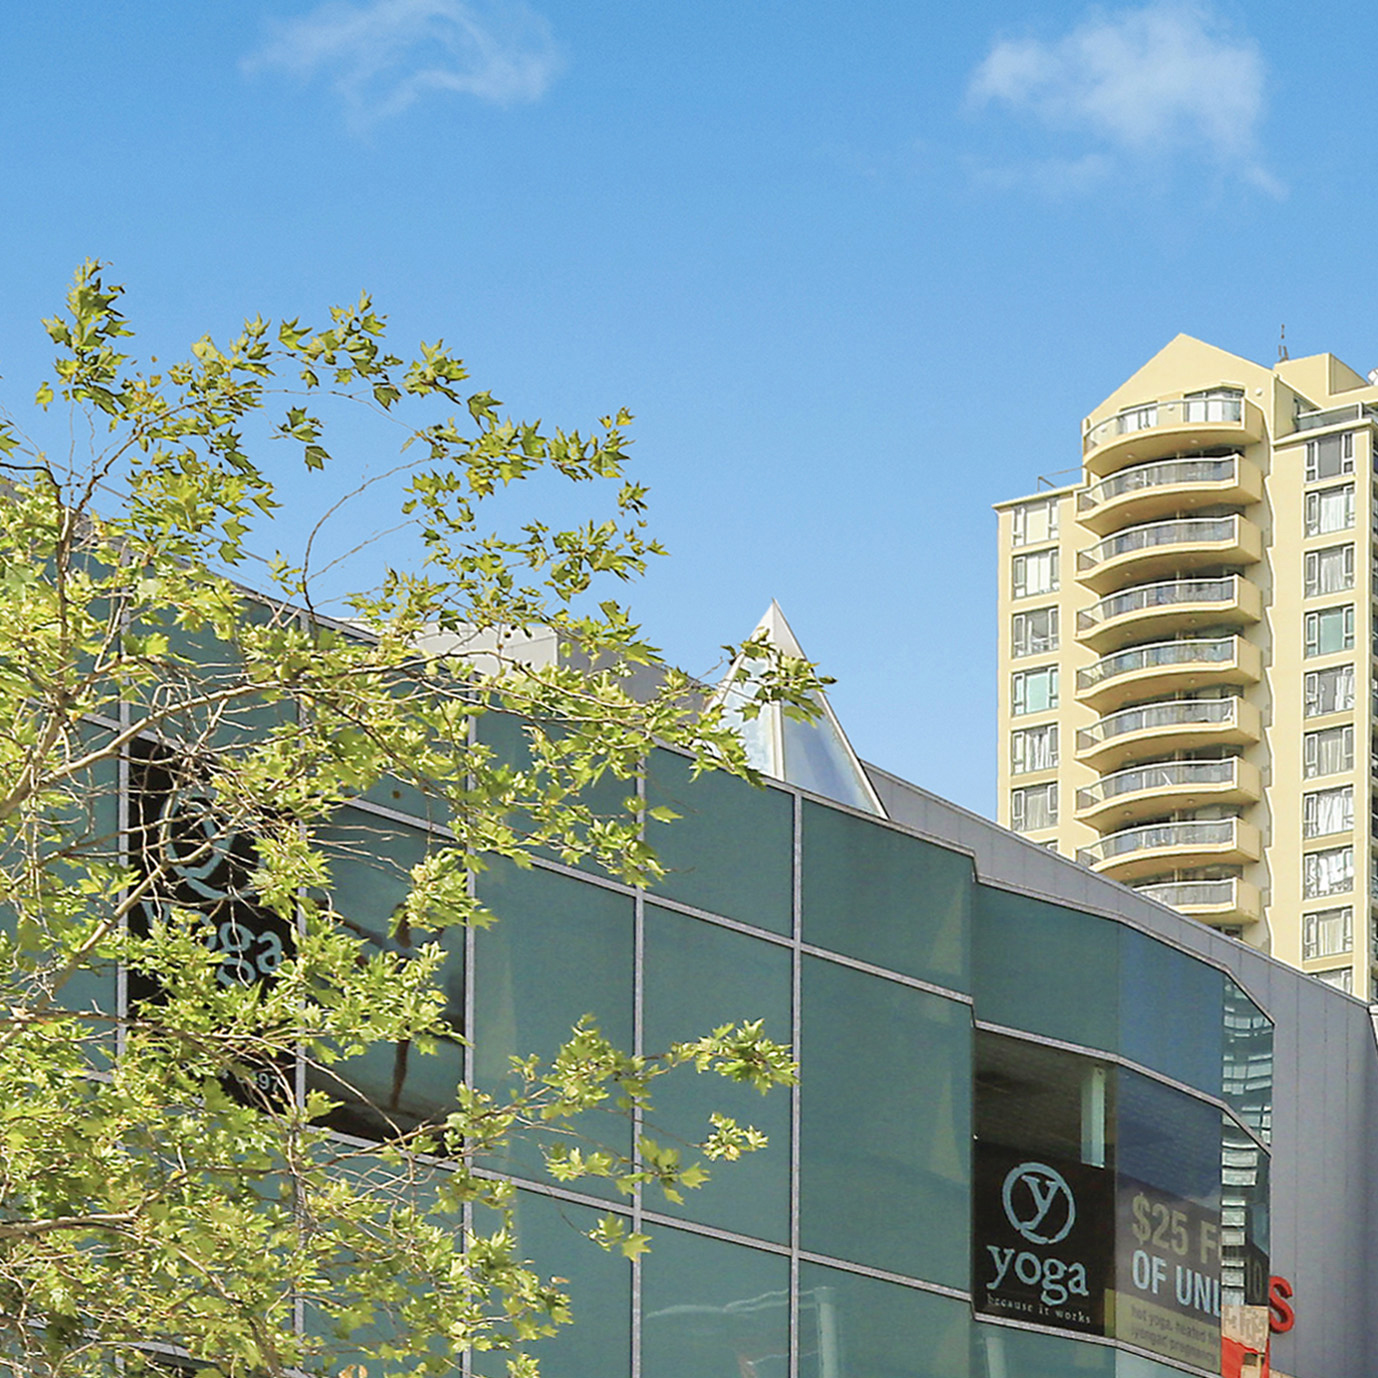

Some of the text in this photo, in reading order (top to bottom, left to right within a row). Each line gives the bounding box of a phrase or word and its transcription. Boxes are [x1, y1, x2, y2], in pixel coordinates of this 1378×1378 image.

[1131, 1192, 1189, 1256] $25
[986, 1245, 1089, 1306] yoga
[1132, 1249, 1168, 1294] OF
[987, 1293, 1092, 1325] because it works
